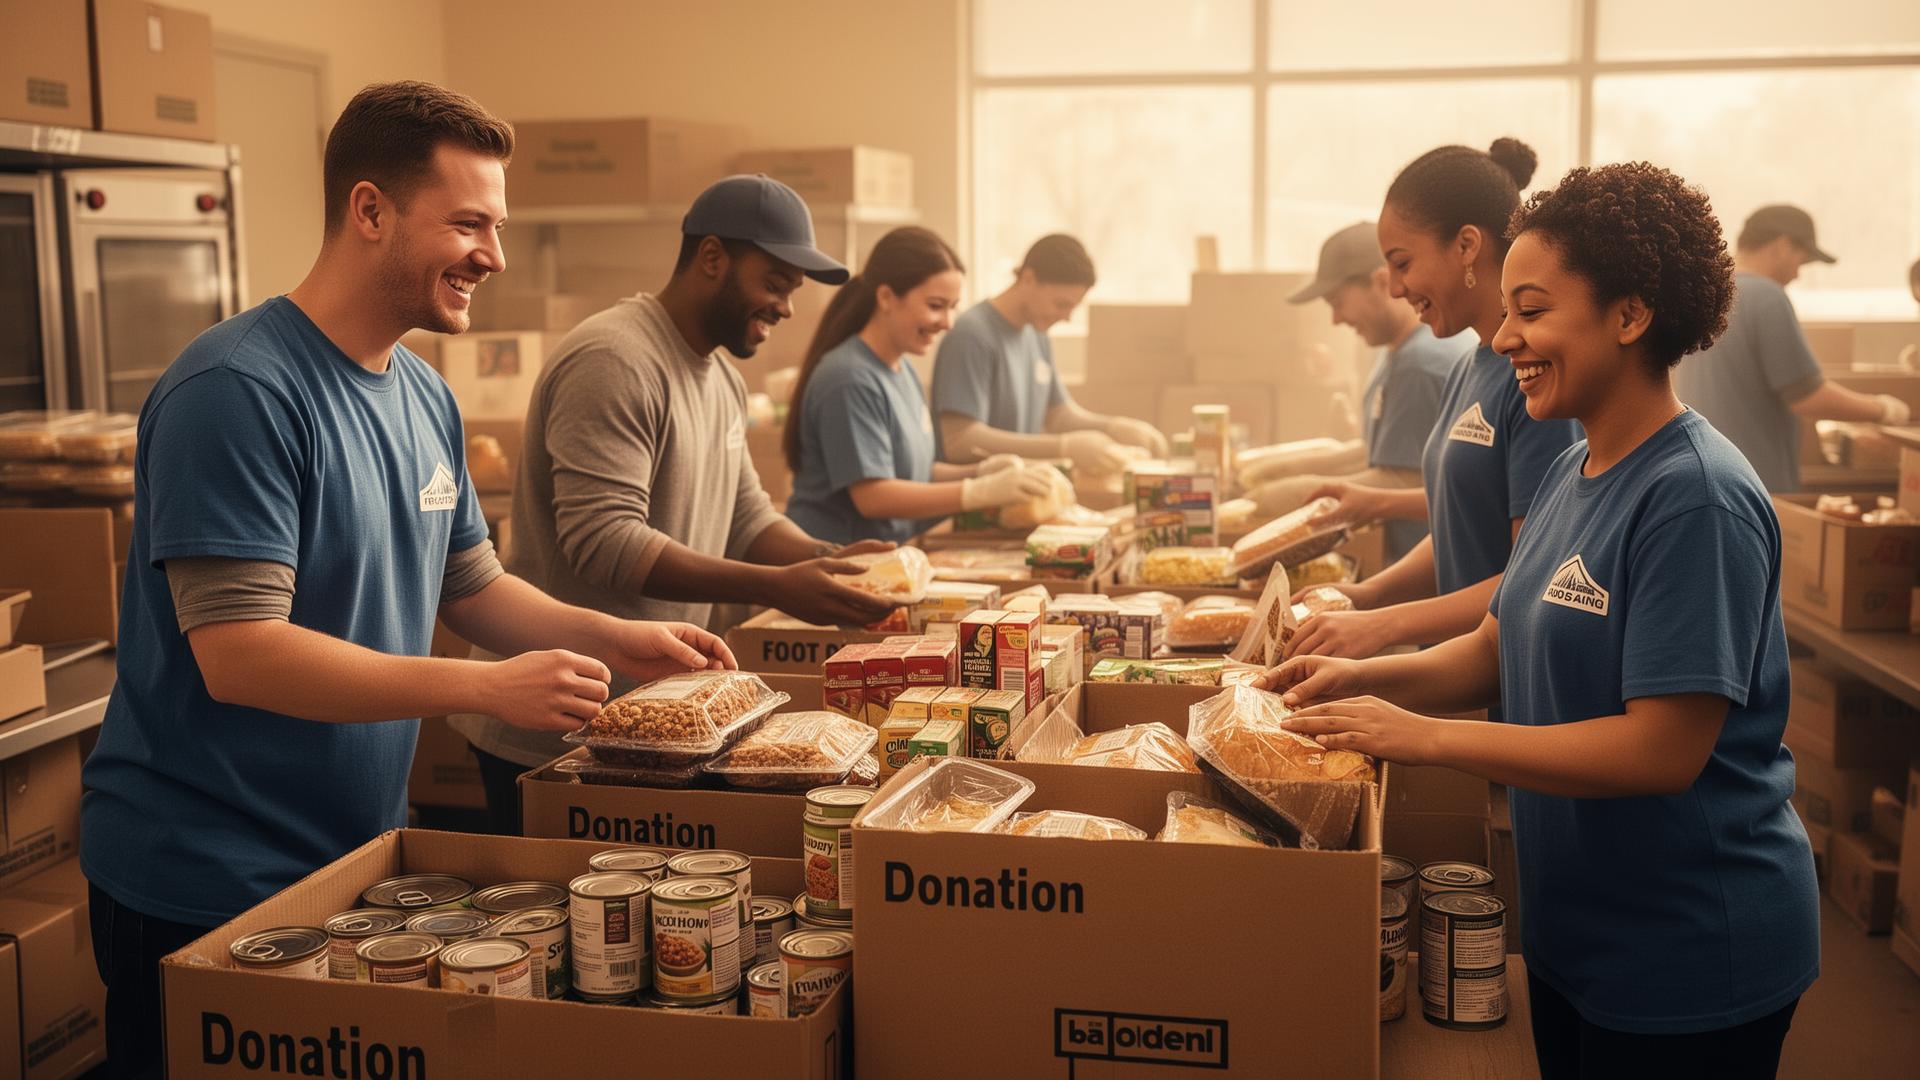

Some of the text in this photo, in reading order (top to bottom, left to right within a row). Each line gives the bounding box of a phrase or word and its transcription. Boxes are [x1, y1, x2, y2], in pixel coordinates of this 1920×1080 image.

[763, 640, 819, 663] FOOT
[568, 805, 716, 849] Donation
[884, 861, 1084, 914] Donation
[201, 1011, 426, 1080] Donation
